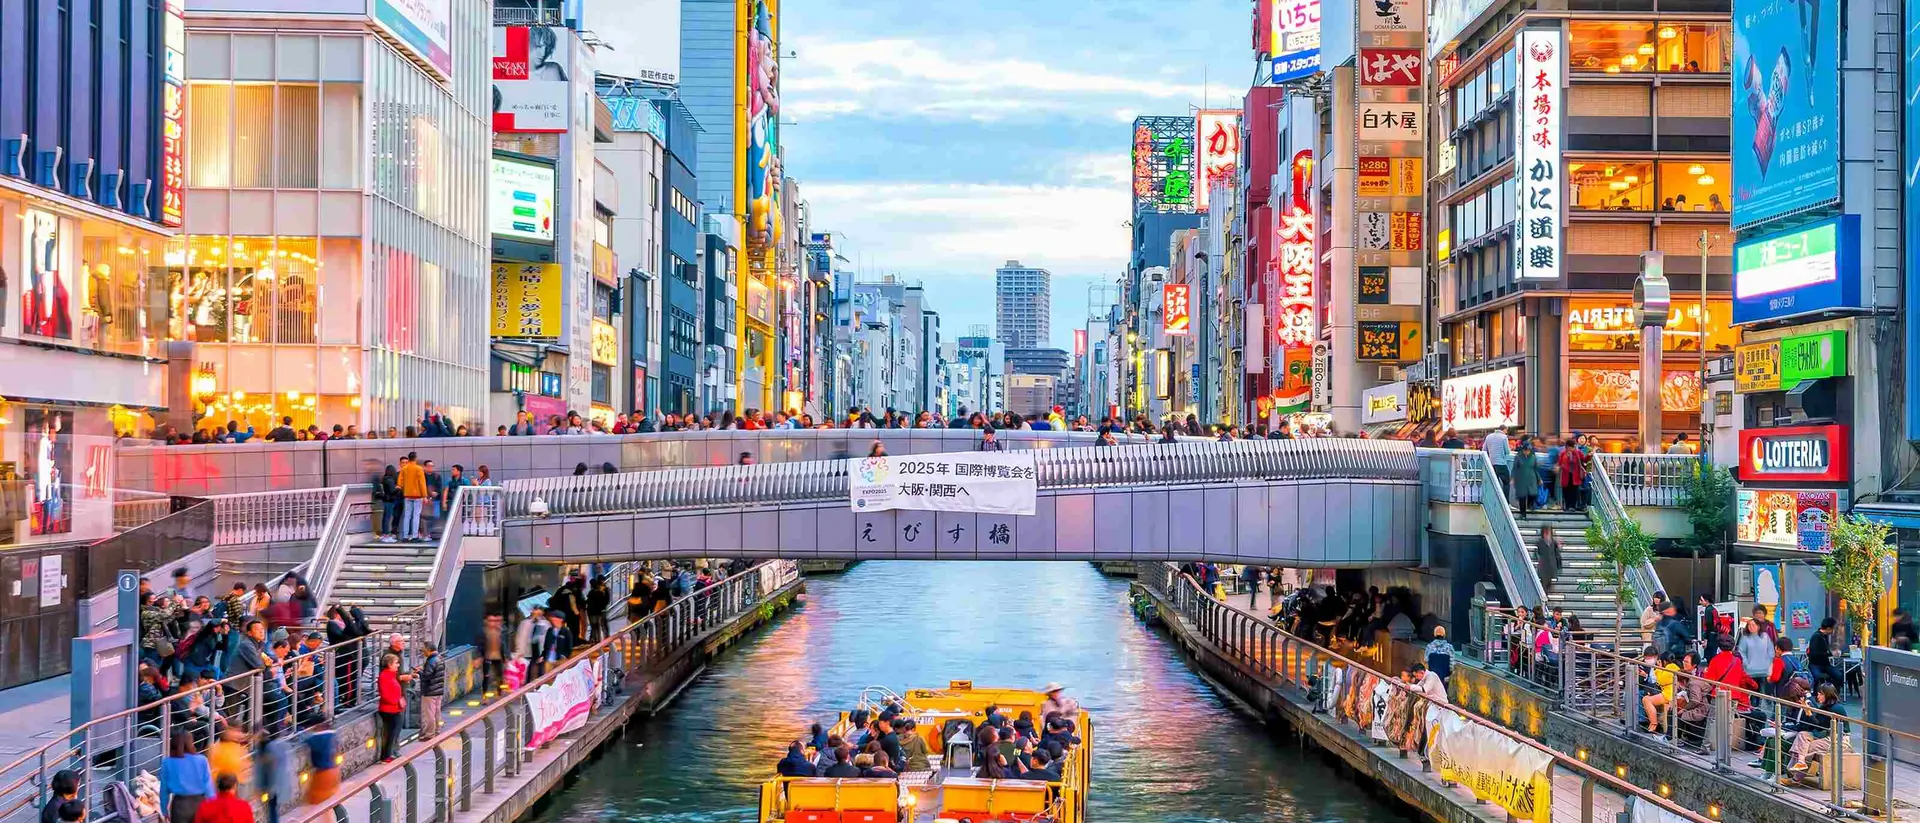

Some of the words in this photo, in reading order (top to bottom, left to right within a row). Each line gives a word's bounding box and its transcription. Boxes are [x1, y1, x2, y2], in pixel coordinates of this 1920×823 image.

[1373, 35, 1390, 45] 5F
[1364, 108, 1417, 129] 白木屋
[1532, 69, 1551, 149] 本場の味
[1530, 158, 1553, 268] かに道楽
[1277, 207, 1314, 345] 大阪王将
[1364, 277, 1384, 286] びっくり
[519, 265, 543, 335] 素晴らしい夢の実現
[1364, 330, 1395, 344] びっくり
[1362, 344, 1398, 357] ドンキー
[1464, 384, 1491, 420] かに道楽
[1766, 440, 1822, 468] LOTTERIA
[899, 462, 950, 476] 2025年
[955, 462, 1034, 480] 国際博覧会を
[898, 483, 970, 497] 大阪・関西へ
[861, 522, 1011, 544] えびす橋
[1892, 673, 1918, 687] information
